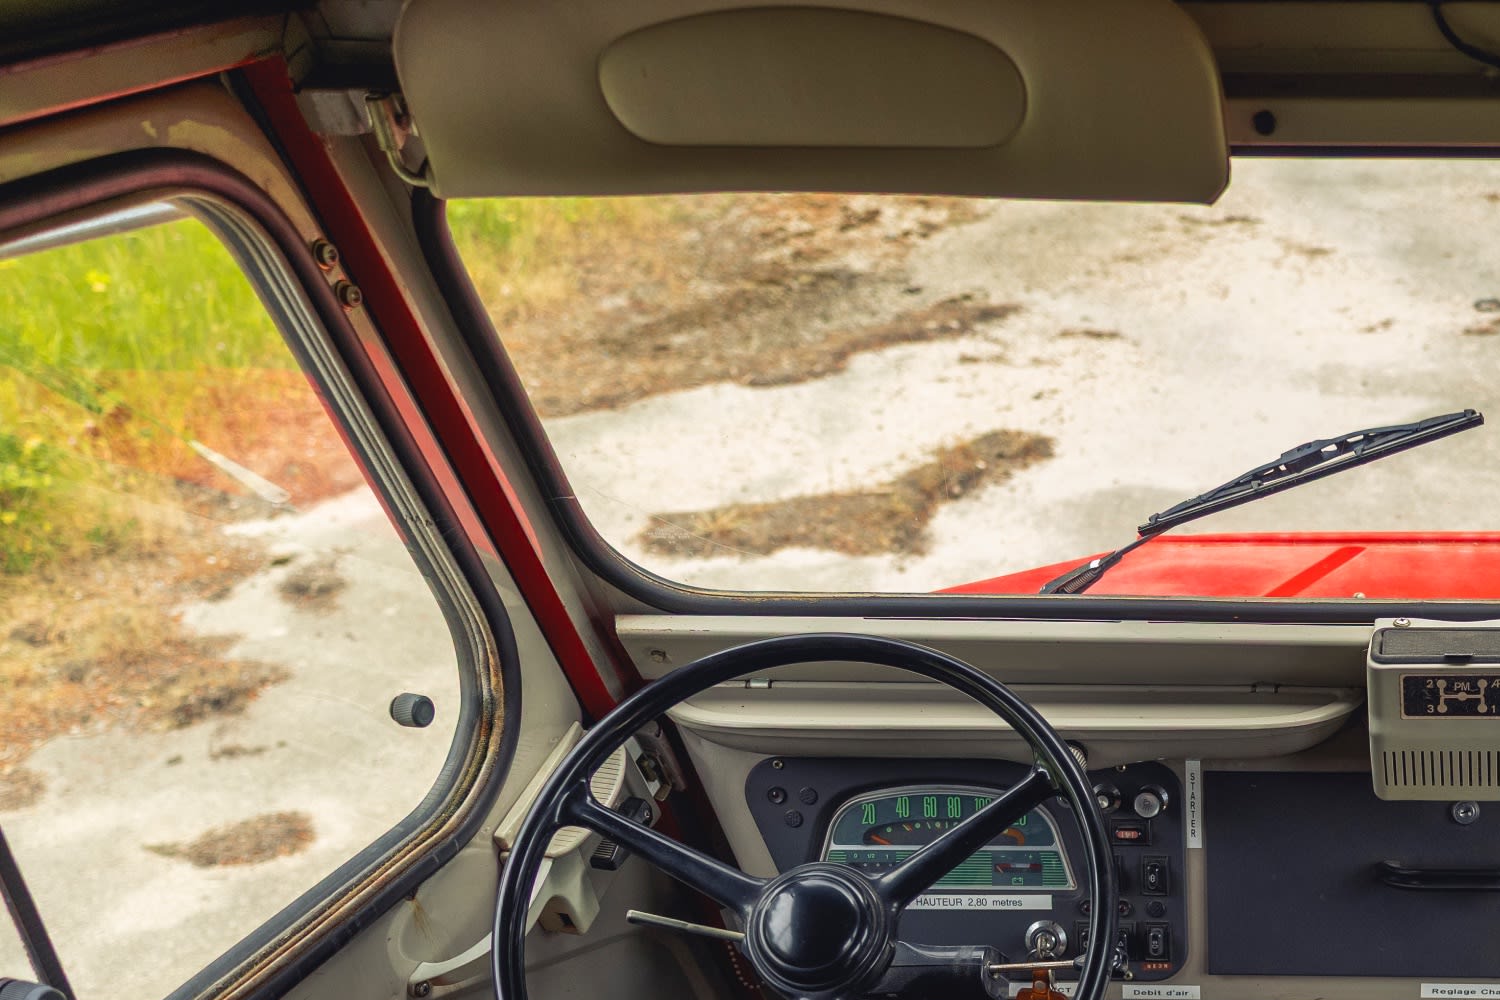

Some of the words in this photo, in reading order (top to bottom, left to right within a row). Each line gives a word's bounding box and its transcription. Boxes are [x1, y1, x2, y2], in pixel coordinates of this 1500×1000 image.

[1426, 679, 1434, 688] 2
[1453, 681, 1470, 691] PM
[1427, 704, 1434, 713] 3
[1491, 704, 1496, 713] 1
[861, 803, 876, 825] 20
[896, 796, 910, 818] 40
[923, 796, 937, 818] 60
[947, 796, 961, 818] 80
[916, 897, 963, 907] HAUTEUR
[967, 897, 988, 908] 2,80
[992, 898, 1023, 907] metres
[1431, 988, 1477, 997] Reglage
